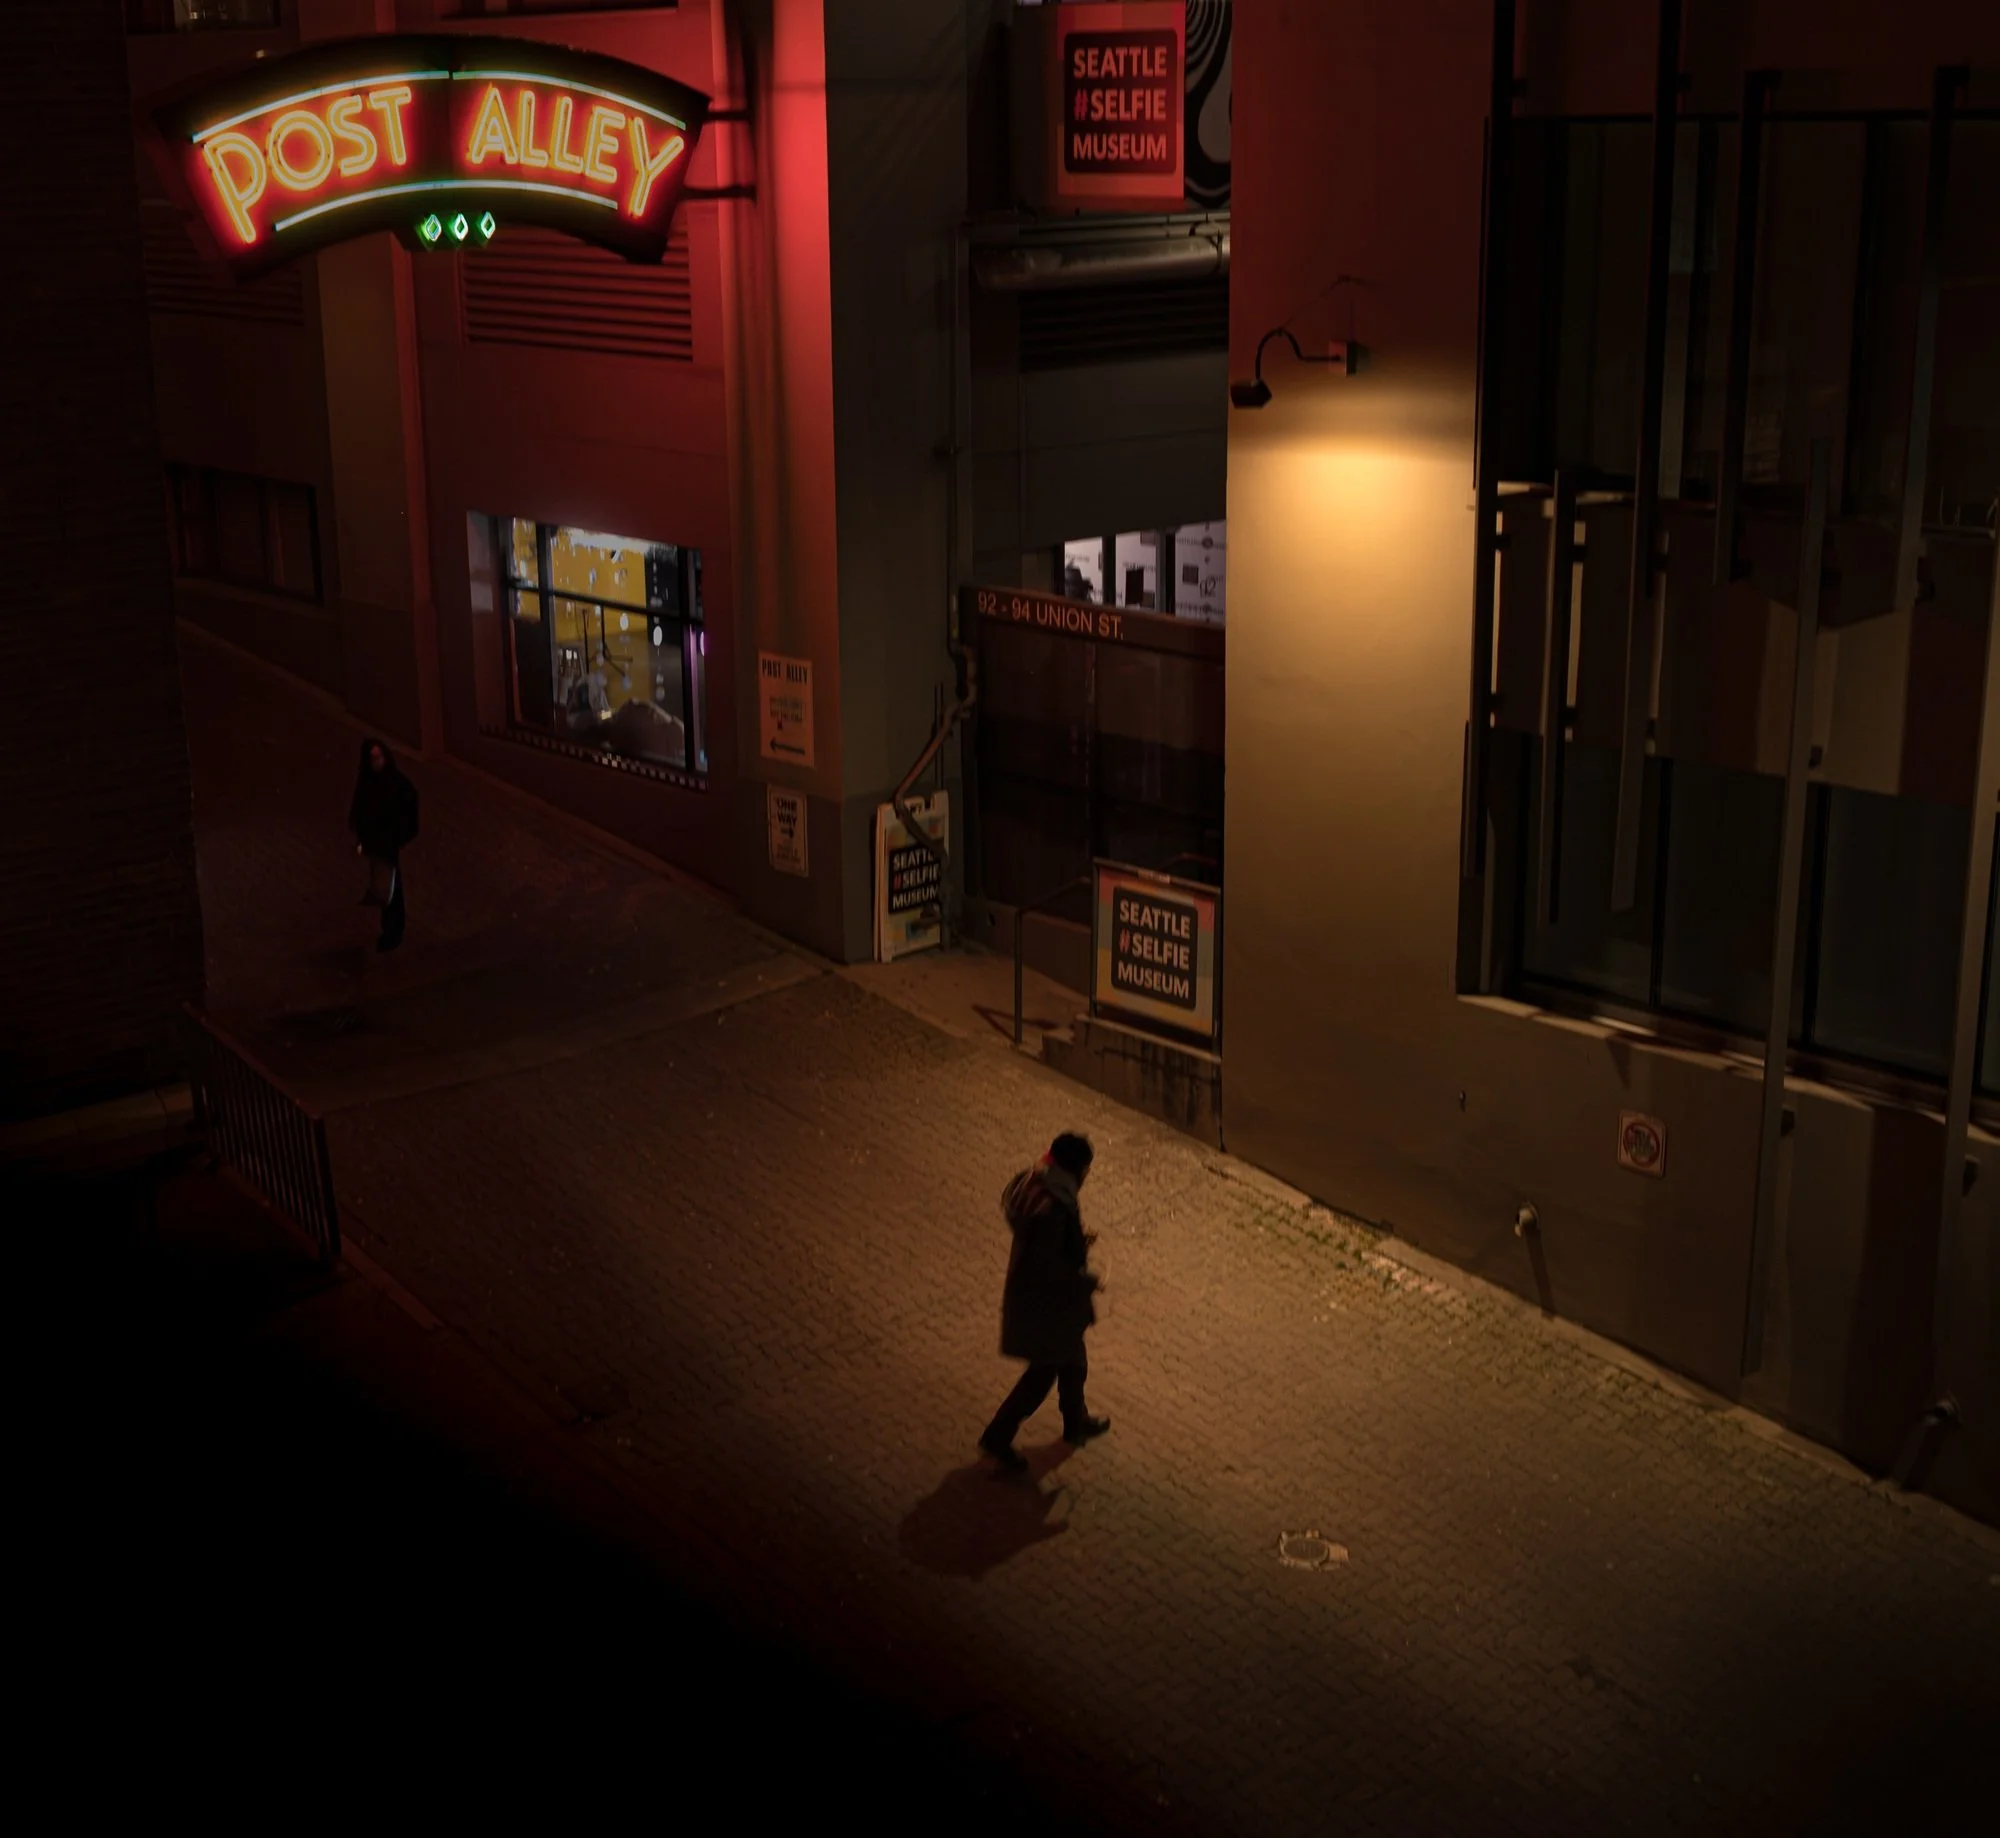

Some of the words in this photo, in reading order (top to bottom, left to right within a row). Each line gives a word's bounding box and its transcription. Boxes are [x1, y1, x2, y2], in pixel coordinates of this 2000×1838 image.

[1072, 45, 1167, 79] SEATTLE
[1073, 87, 1167, 121] #SELFIE
[201, 86, 412, 244] POST
[469, 85, 686, 217] ALLEY
[1073, 132, 1167, 161] MUSEUM
[977, 590, 997, 616] 92
[1011, 596, 1031, 622] 94
[1036, 601, 1093, 634] UNION
[1098, 611, 1124, 641] ST.
[1119, 898, 1191, 940] SEATTLE
[1119, 927, 1190, 971] #SELFIE
[1117, 959, 1190, 1000] MUSEUM
